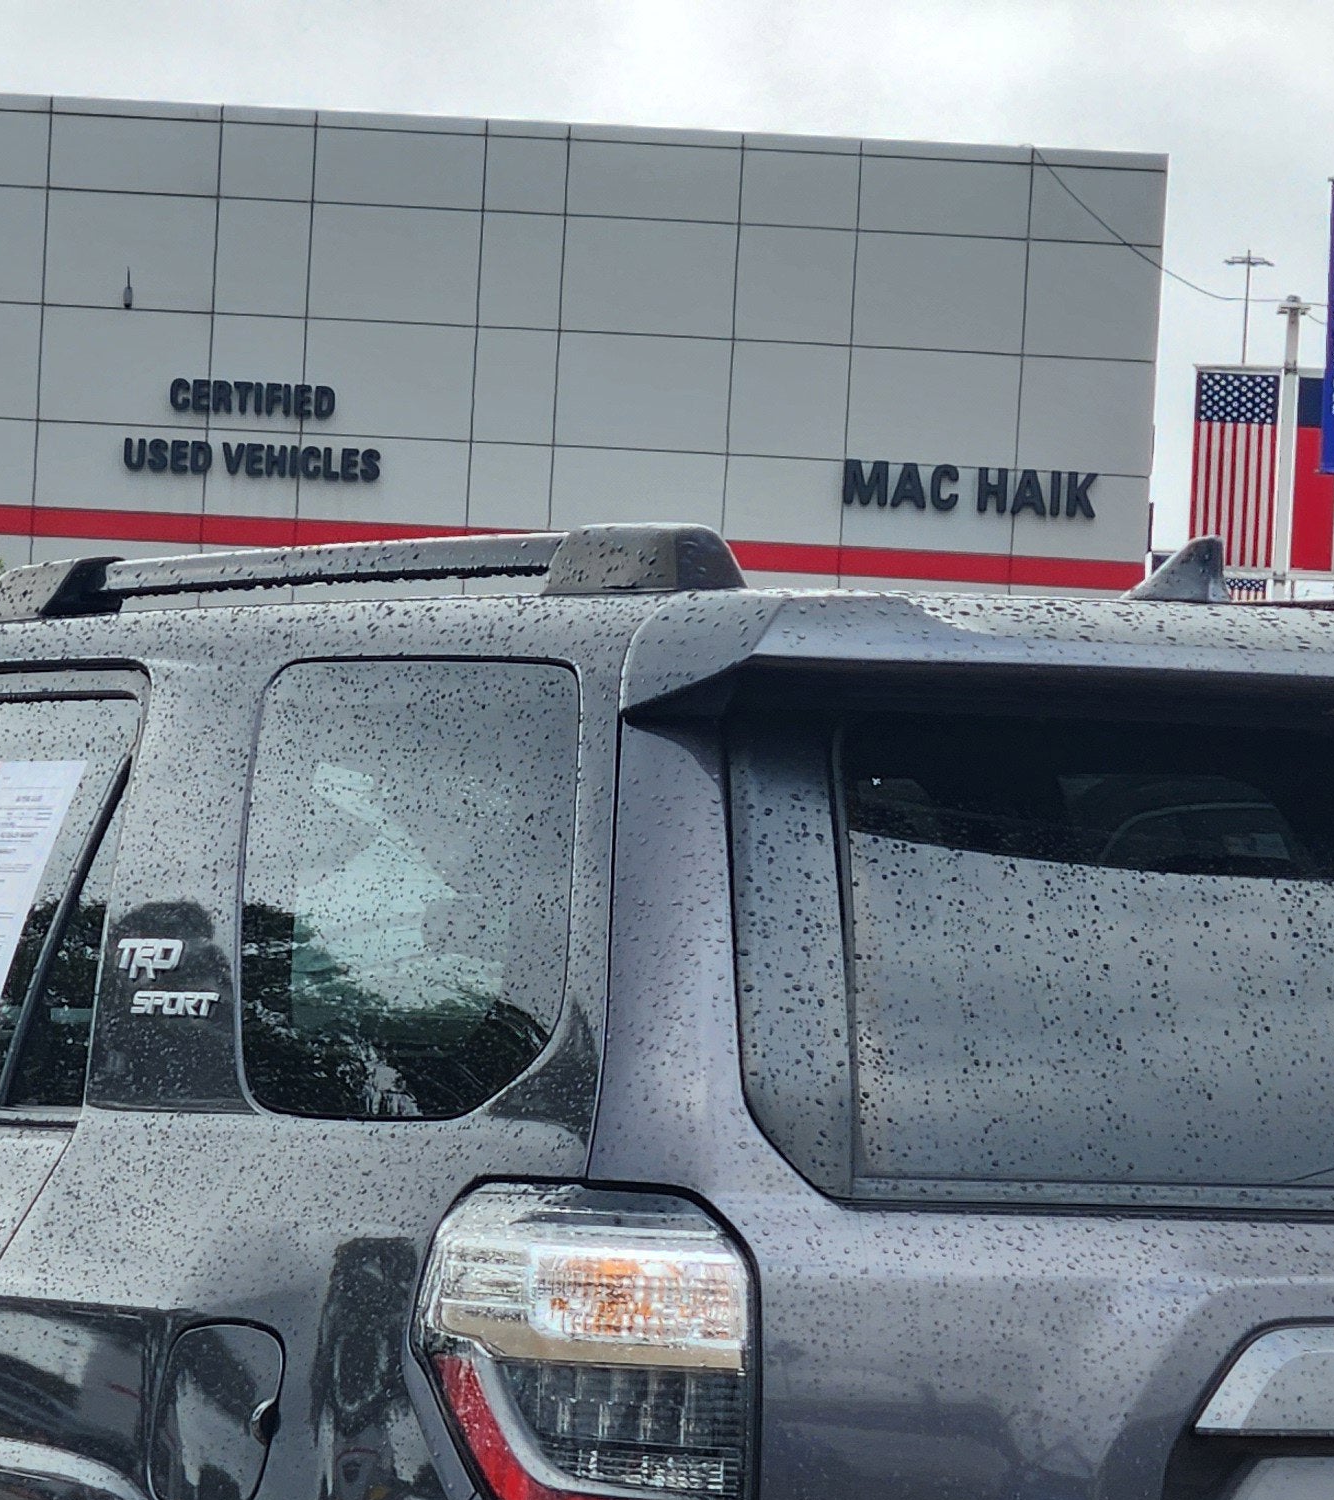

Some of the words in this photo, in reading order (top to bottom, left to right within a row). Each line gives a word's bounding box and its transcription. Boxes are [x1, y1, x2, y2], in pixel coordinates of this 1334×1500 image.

[169, 377, 336, 420] CERTIFIED
[123, 437, 213, 476] USED
[222, 441, 382, 483] VEHICLES
[842, 458, 960, 512] MAC
[976, 466, 1099, 519] HAIK
[117, 937, 184, 980] TRD
[130, 990, 220, 1017] SPORT
